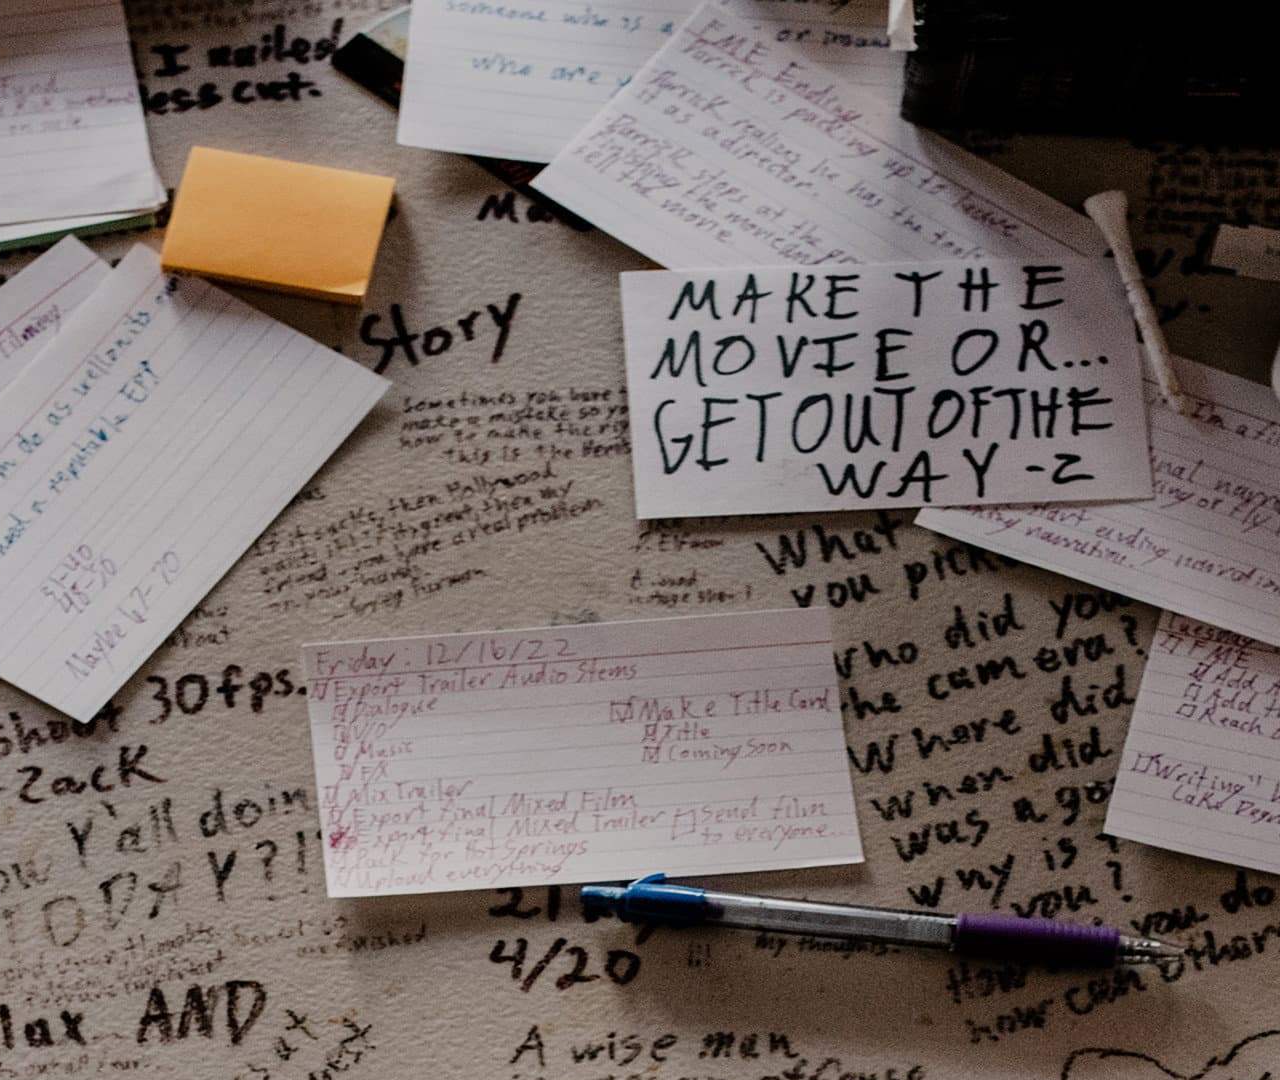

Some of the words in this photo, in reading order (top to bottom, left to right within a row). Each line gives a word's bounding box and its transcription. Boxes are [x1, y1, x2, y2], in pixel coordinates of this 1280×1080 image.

[669, 271, 862, 324] MAKE
[893, 264, 1066, 318] THE
[359, 291, 523, 375] Story
[649, 327, 914, 388] MOVIE
[950, 318, 1111, 377] OR...
[814, 442, 1001, 503] WAY
[755, 509, 904, 575] What
[945, 593, 1025, 649] did
[65, 623, 127, 680] Maybe
[331, 677, 408, 702] Export
[418, 666, 493, 694] Trailer
[499, 662, 572, 691] Audio
[575, 659, 639, 684] Stems
[638, 696, 717, 723] Make
[730, 689, 782, 716] Title
[785, 687, 833, 714] Card
[1050, 665, 1136, 724] did
[1198, 706, 1266, 739] Reach
[1028, 726, 1114, 773] did
[502, 792, 574, 816] Mixed
[578, 788, 638, 812] Film
[506, 813, 586, 838] Mixed
[592, 809, 667, 833] Trailer
[699, 797, 758, 820] Send
[498, 839, 590, 872] Springs
[890, 810, 990, 863] was
[1042, 836, 1077, 871] is
[489, 937, 641, 993] 4/20
[135, 986, 270, 1046] AND
[509, 1024, 546, 1069] A
[570, 1030, 679, 1068] wise
[697, 1030, 800, 1061] man
